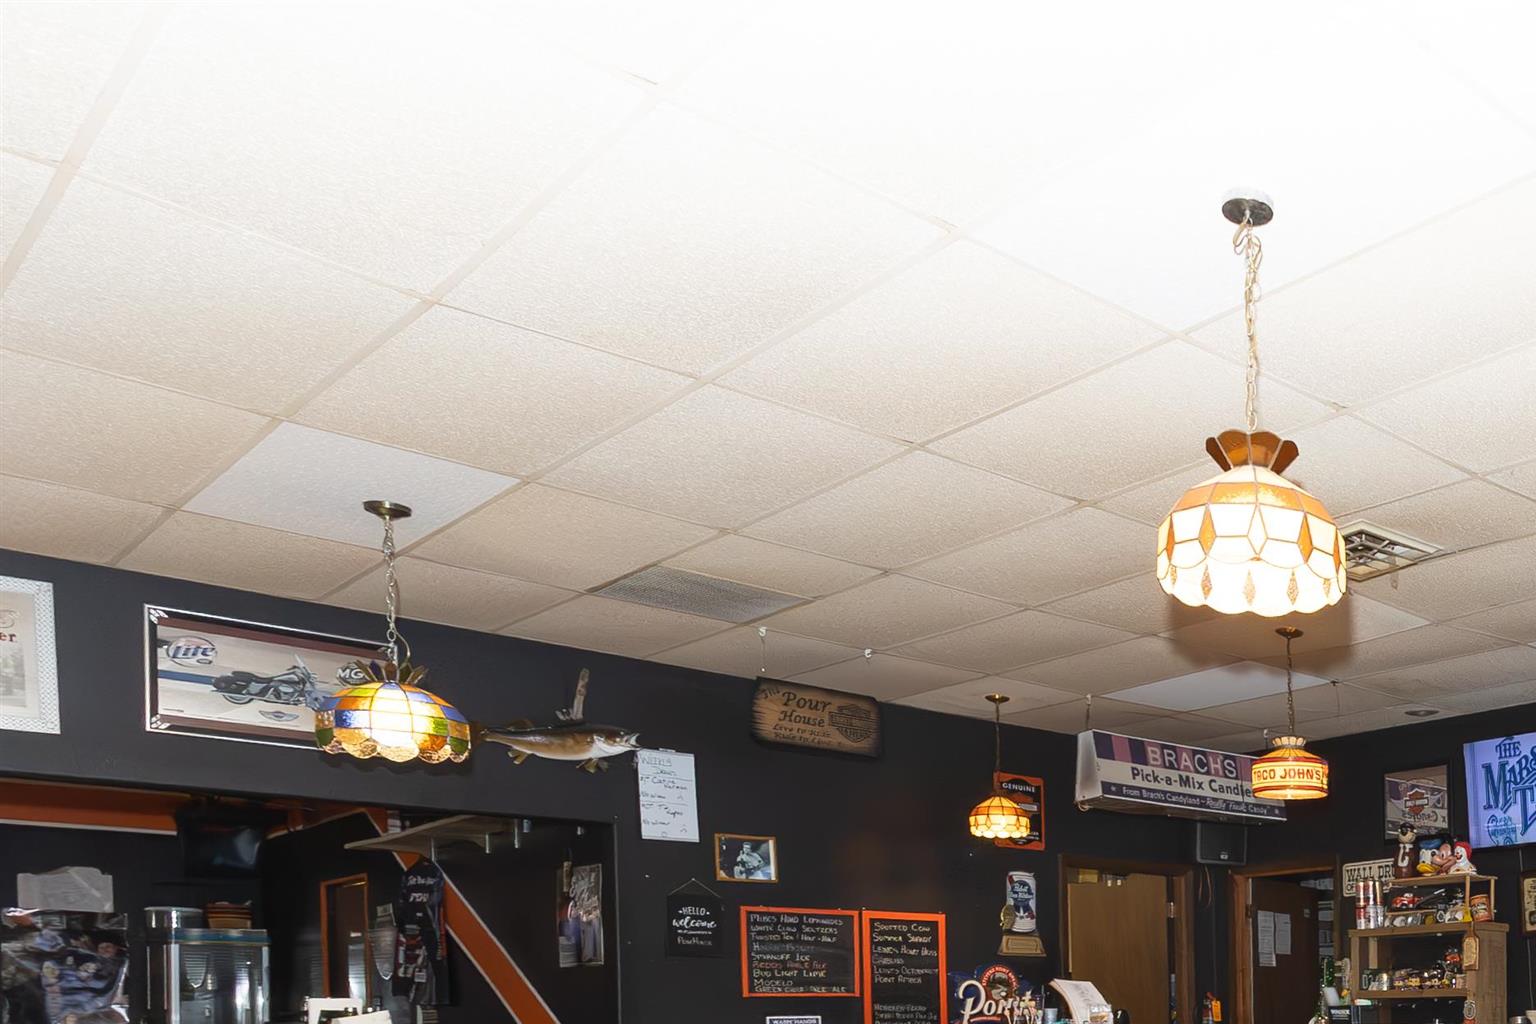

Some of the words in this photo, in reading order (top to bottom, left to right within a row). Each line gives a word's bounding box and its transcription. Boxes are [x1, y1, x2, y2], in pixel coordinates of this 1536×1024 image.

[336, 668, 365, 679] MG
[781, 691, 832, 713] Pour
[778, 709, 825, 728] House
[1496, 737, 1522, 759] THE
[1002, 782, 1036, 793] GENUINE
[1131, 767, 1205, 791] Pick-a-Mix
[1208, 780, 1252, 798] Candie
[1346, 866, 1375, 882] WALL
[682, 906, 706, 916] HELLO
